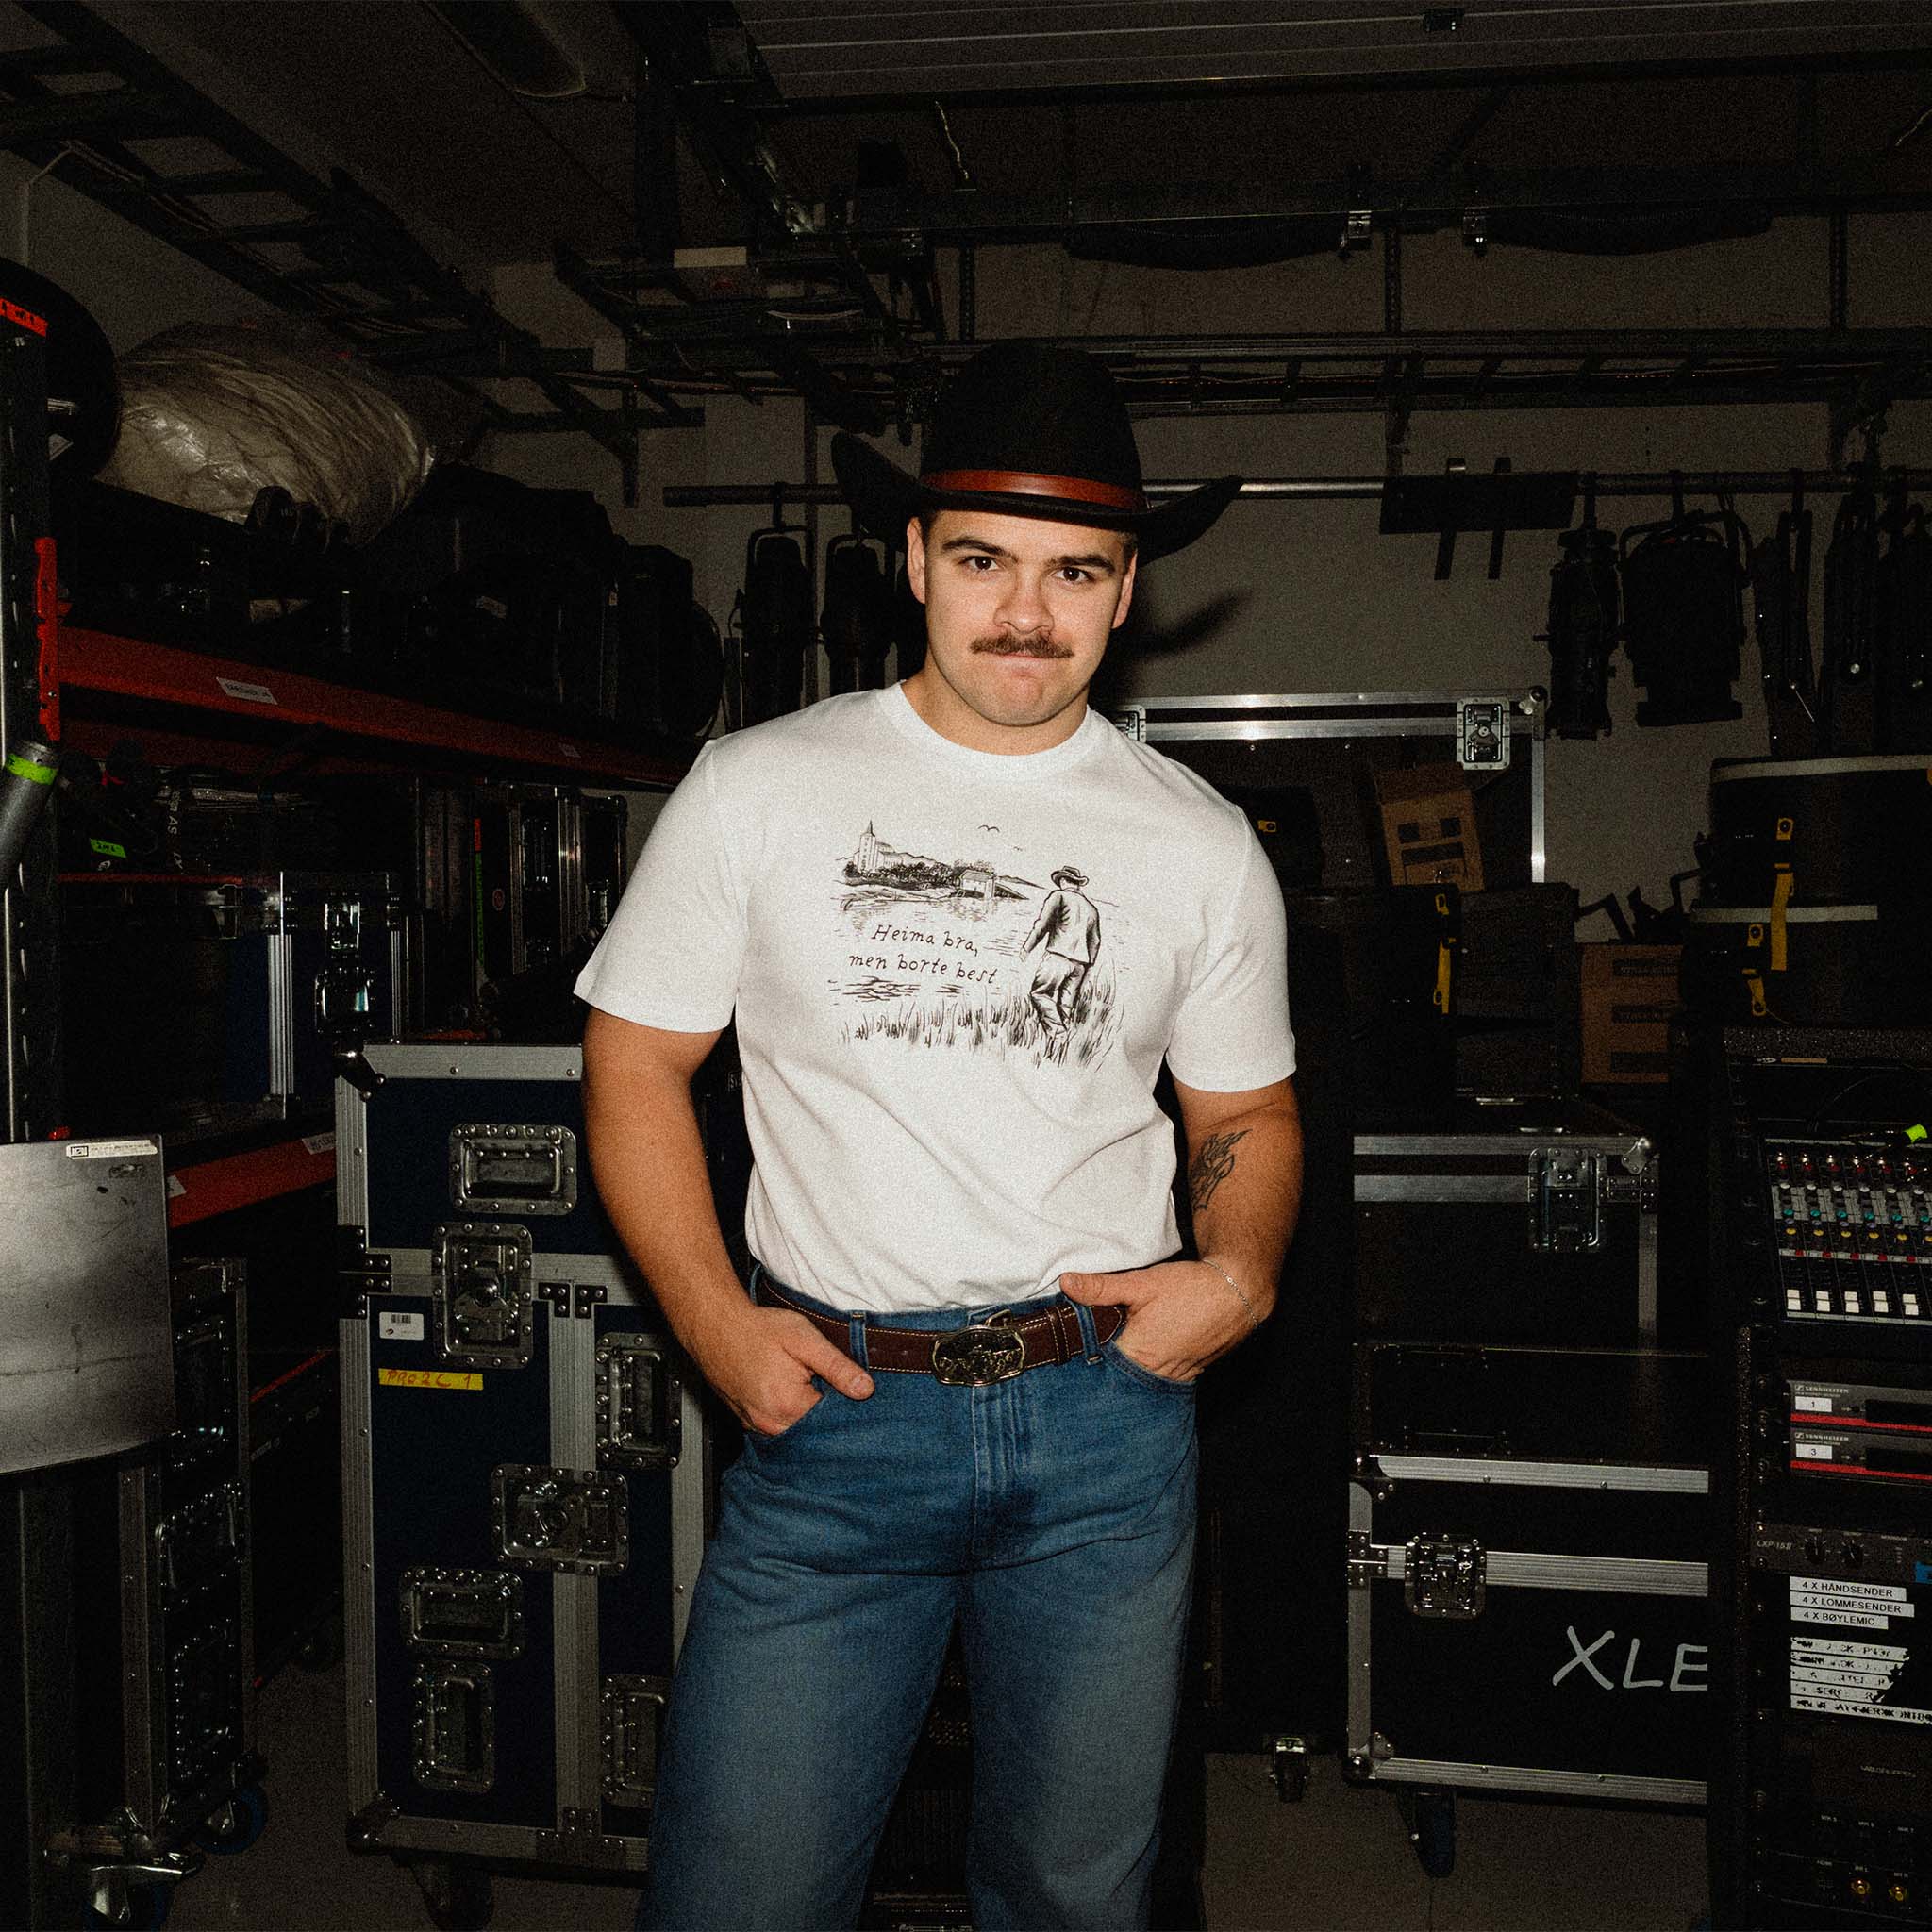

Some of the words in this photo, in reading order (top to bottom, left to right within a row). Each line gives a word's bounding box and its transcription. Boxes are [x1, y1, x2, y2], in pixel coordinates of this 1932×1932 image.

[871, 924, 935, 944] Heima
[943, 931, 978, 957] bra,
[849, 955, 888, 970] men
[897, 953, 948, 974] borte
[956, 962, 998, 984] best
[1811, 1581, 1818, 1590] X
[1811, 1596, 1818, 1605] X
[1821, 1598, 1902, 1613] LOMMESENDER
[1812, 1611, 1820, 1620] X
[1822, 1613, 1875, 1625] BØYLEMIC
